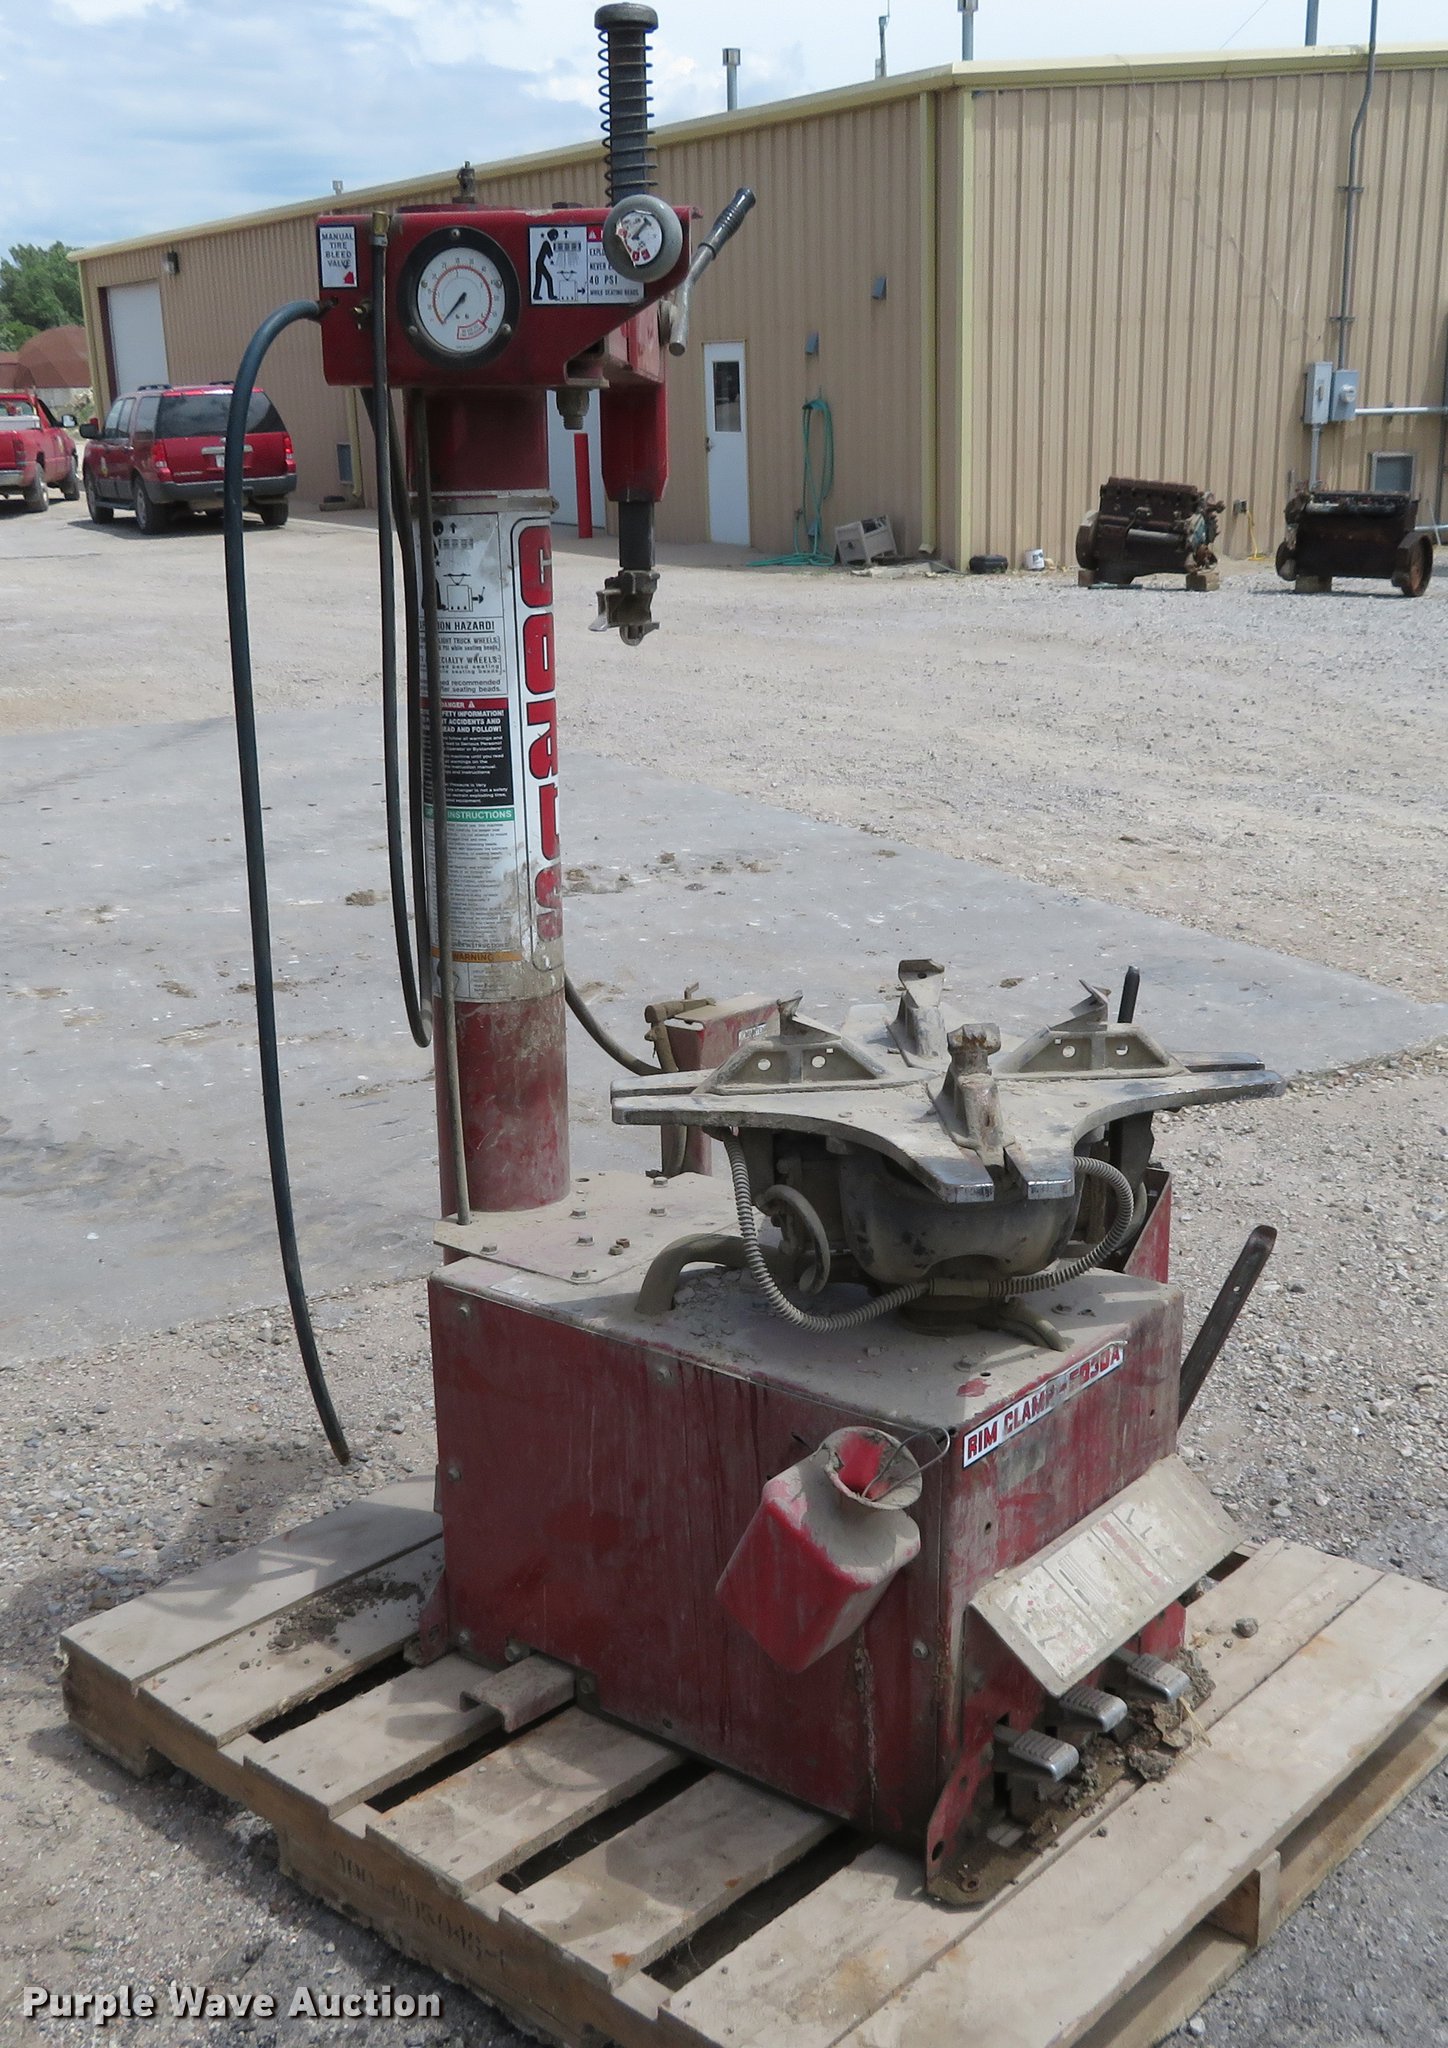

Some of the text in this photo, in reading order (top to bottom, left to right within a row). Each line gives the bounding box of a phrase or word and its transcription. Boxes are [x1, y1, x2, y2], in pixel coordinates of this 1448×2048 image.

[322, 232, 353, 241] MANUAL
[329, 241, 347, 249] TIRE
[325, 250, 352, 258] BLEED
[327, 259, 351, 267] VALVE
[589, 262, 606, 271] NEVER
[589, 275, 618, 285] 40 PSI
[454, 621, 495, 631] HAZARD!
[447, 809, 513, 819] INSTRUCTIONS
[967, 1420, 998, 1460] RIM
[1003, 1385, 1056, 1433] CLAMP
